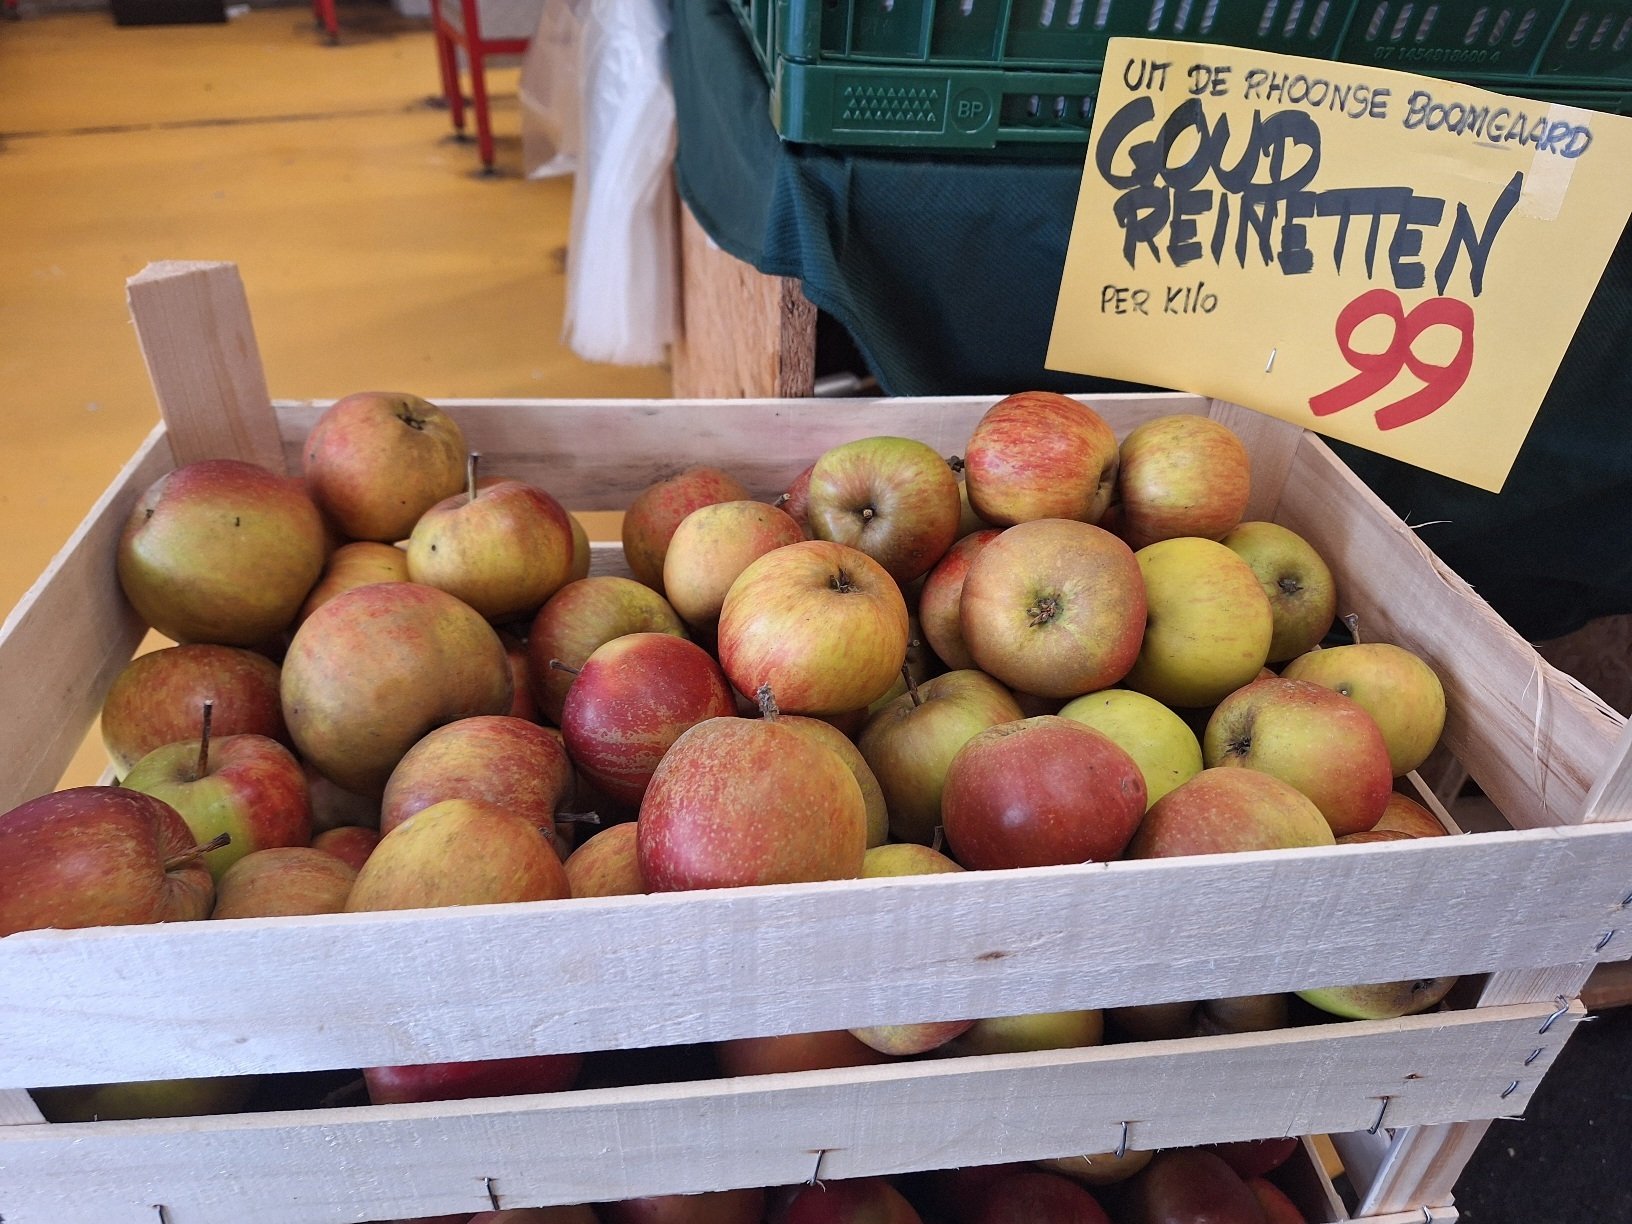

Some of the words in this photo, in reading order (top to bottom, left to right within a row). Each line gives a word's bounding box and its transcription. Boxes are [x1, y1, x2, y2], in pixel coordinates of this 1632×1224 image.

[957, 100, 984, 119] BP
[1096, 96, 1321, 195] GOUD
[1123, 58, 1172, 92] UIT
[1187, 64, 1232, 97] DE
[1243, 68, 1392, 119] RHOONSE
[1403, 90, 1593, 158] BOOMGAARD
[1113, 171, 1524, 297] REINETTEN
[1101, 284, 1149, 316] PER
[1308, 289, 1475, 431] 99
